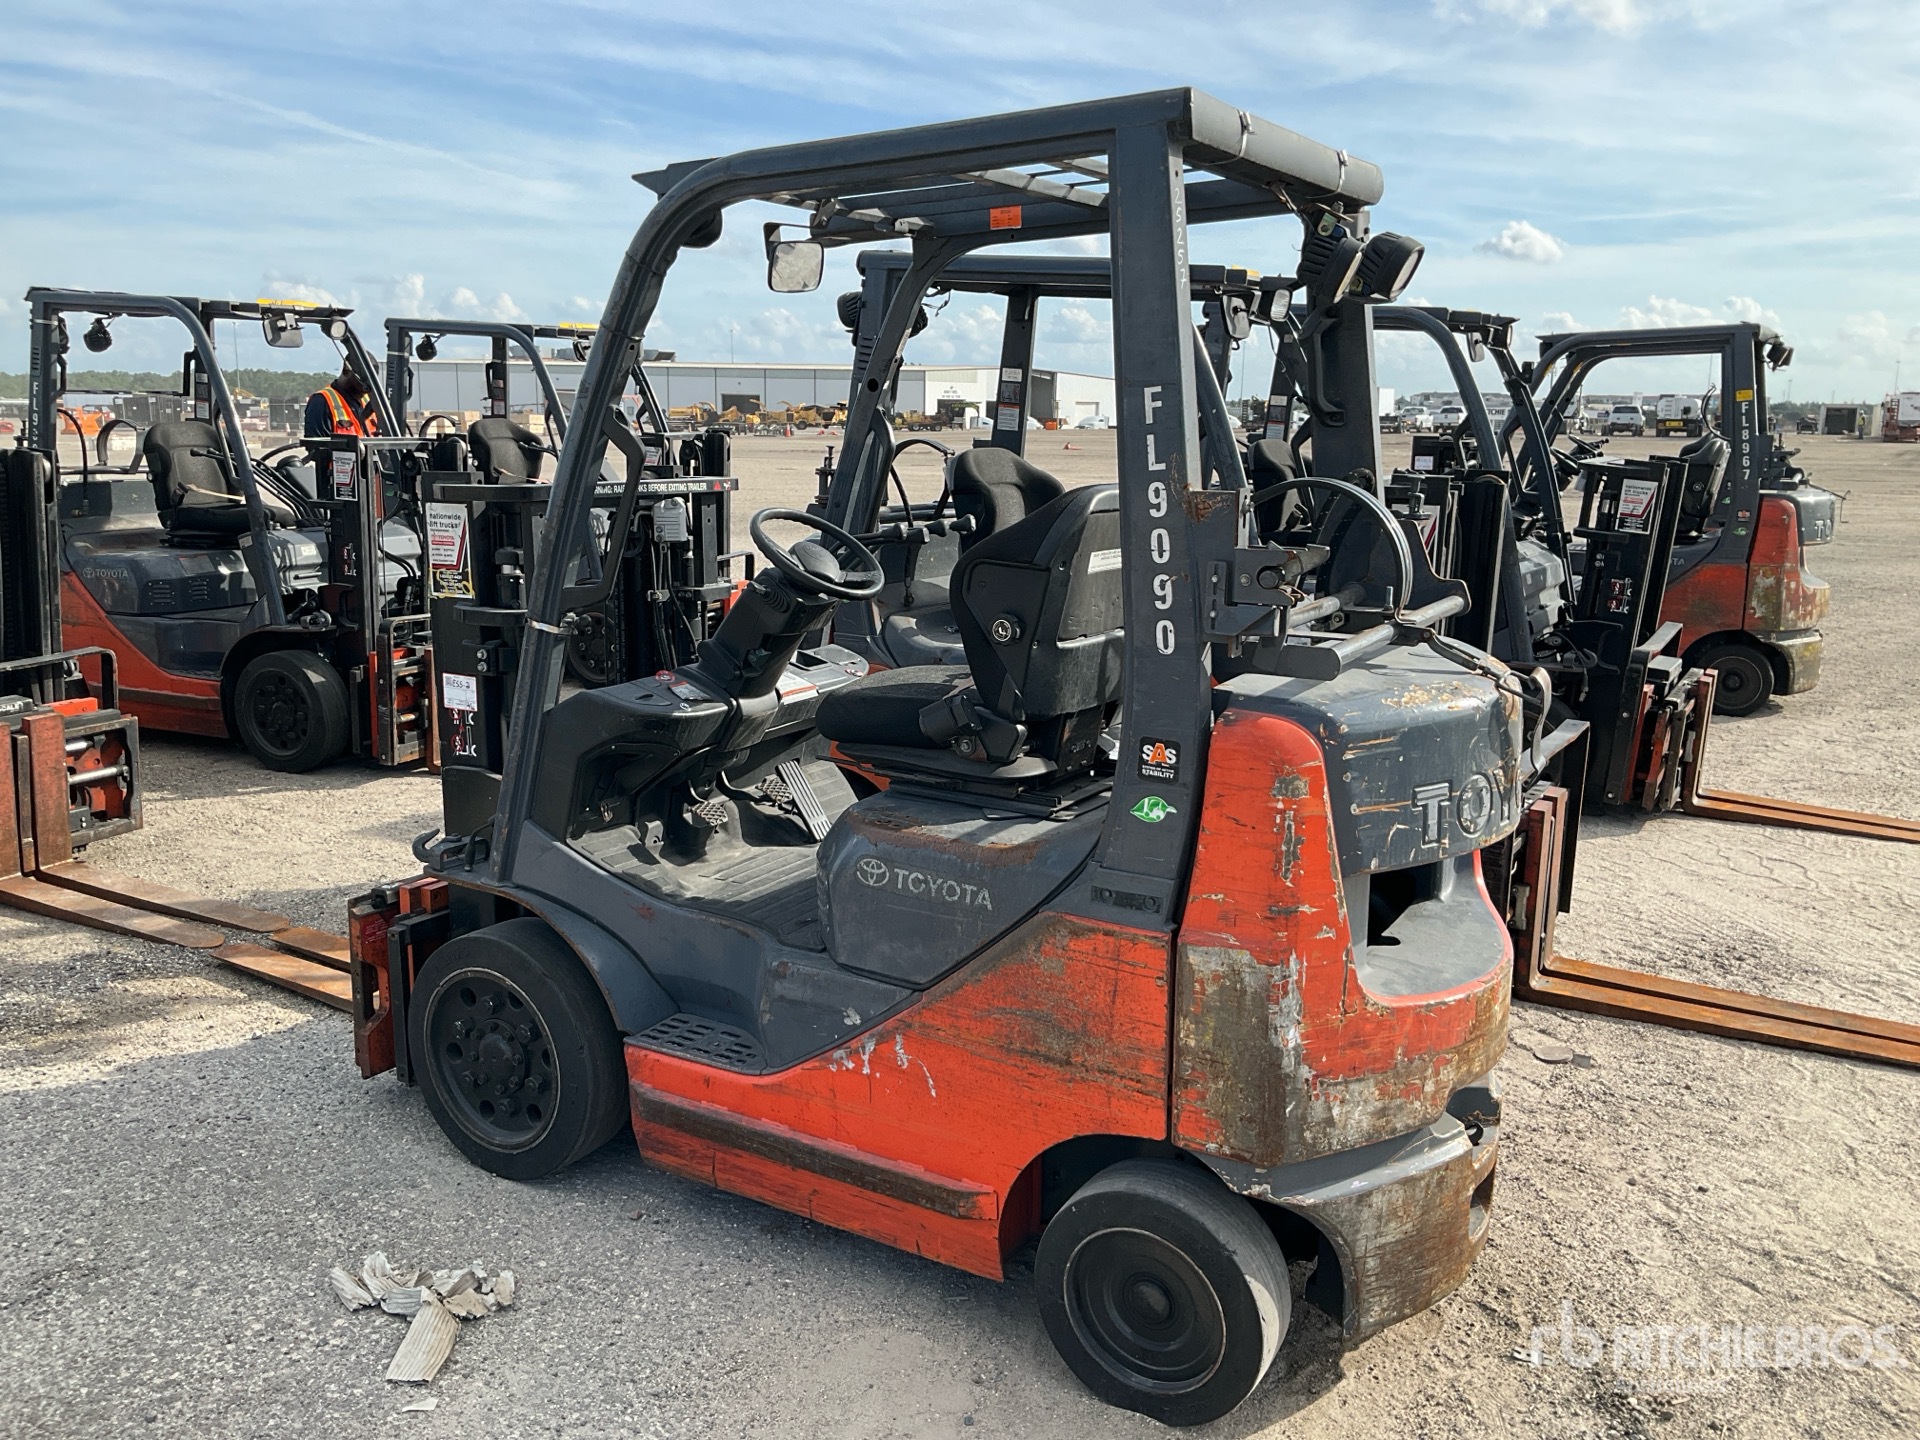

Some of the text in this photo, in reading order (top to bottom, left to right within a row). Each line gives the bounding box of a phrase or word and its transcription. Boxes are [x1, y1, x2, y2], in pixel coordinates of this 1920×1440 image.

[1174, 187, 1187, 290] 25257
[1741, 401, 1751, 481] FL8967
[648, 483, 668, 492] BEFORE
[668, 482, 688, 492] EXITING
[687, 482, 707, 491] TRAILER
[1143, 385, 1176, 656] FL9090
[95, 568, 130, 580] TOYOTA
[1141, 742, 1178, 765] SAS
[1141, 768, 1175, 780] STABILITY
[893, 868, 993, 911] TOYOTA
